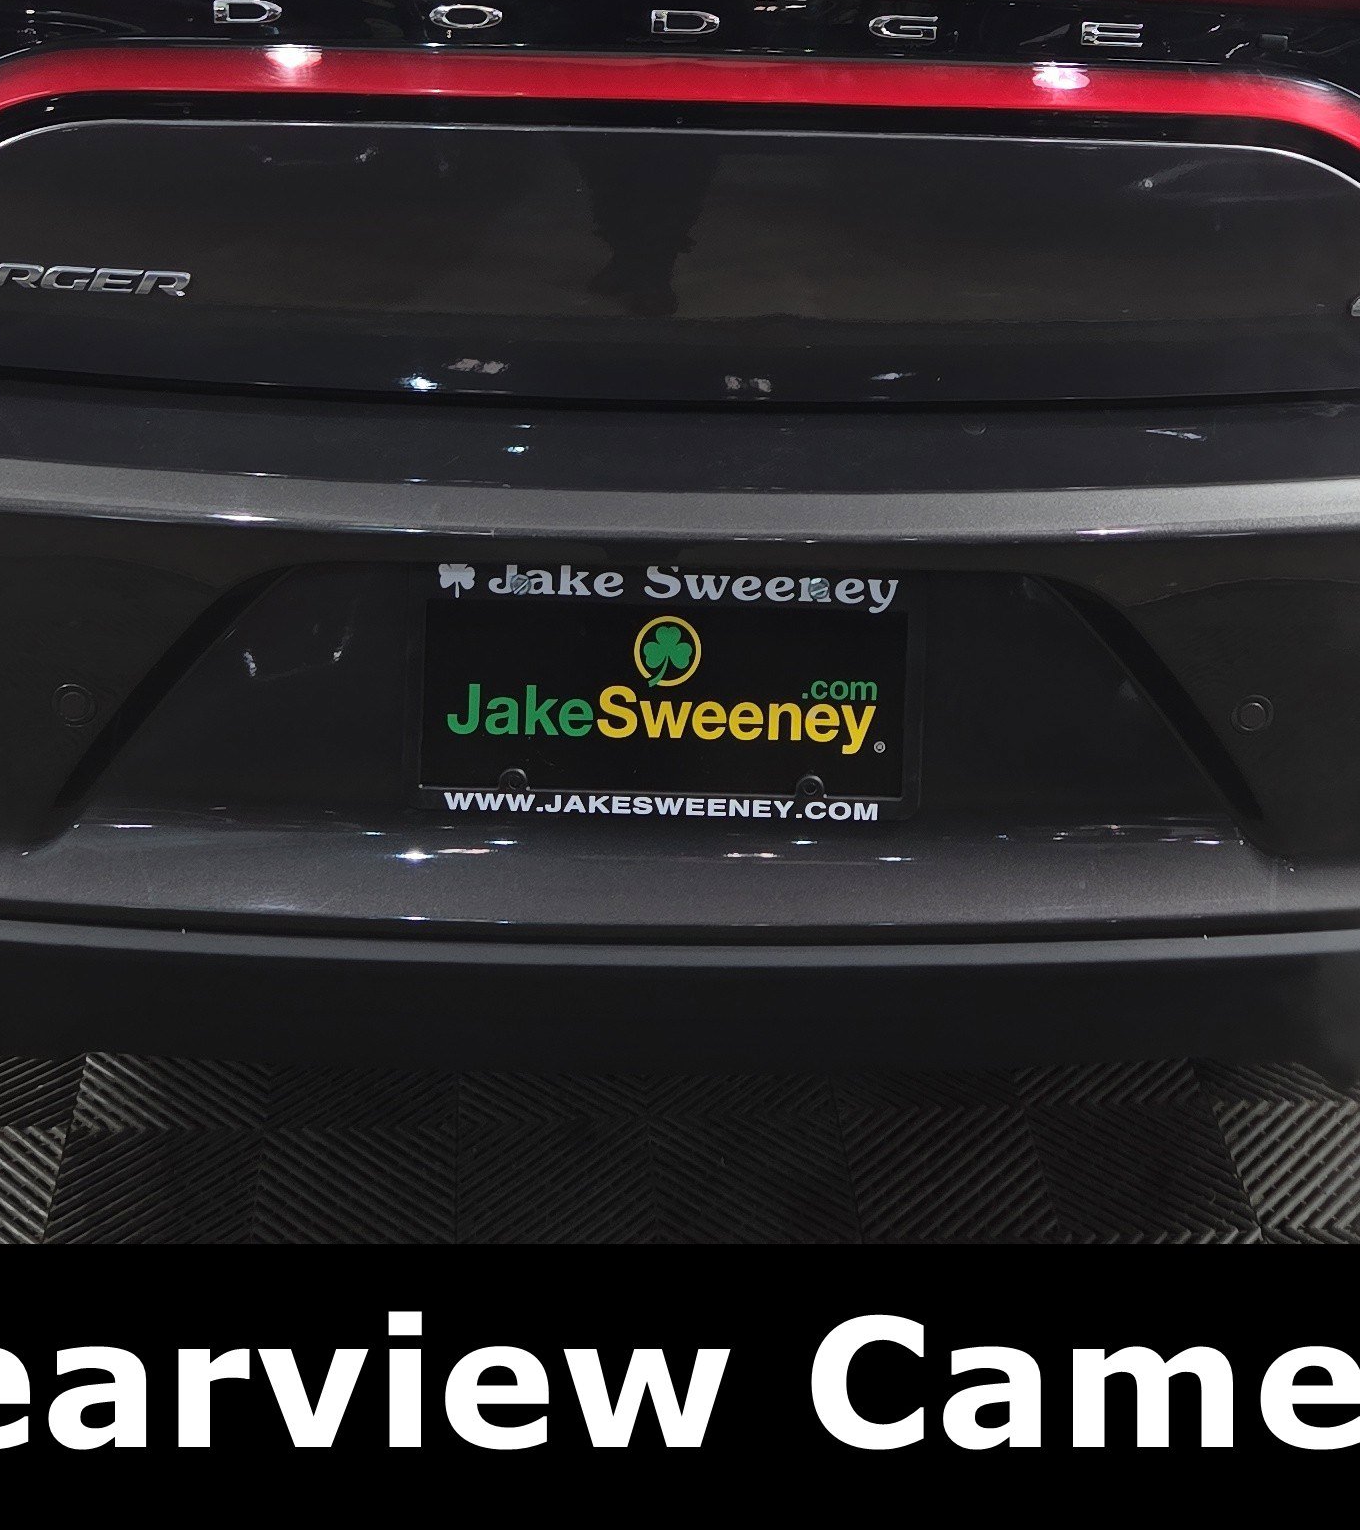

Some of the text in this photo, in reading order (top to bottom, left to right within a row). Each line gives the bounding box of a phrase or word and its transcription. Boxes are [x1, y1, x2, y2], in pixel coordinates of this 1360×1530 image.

[488, 564, 625, 597] Jake
[801, 679, 879, 702] .com
[443, 791, 879, 822] WWW.JAKESWEENEY.COM
